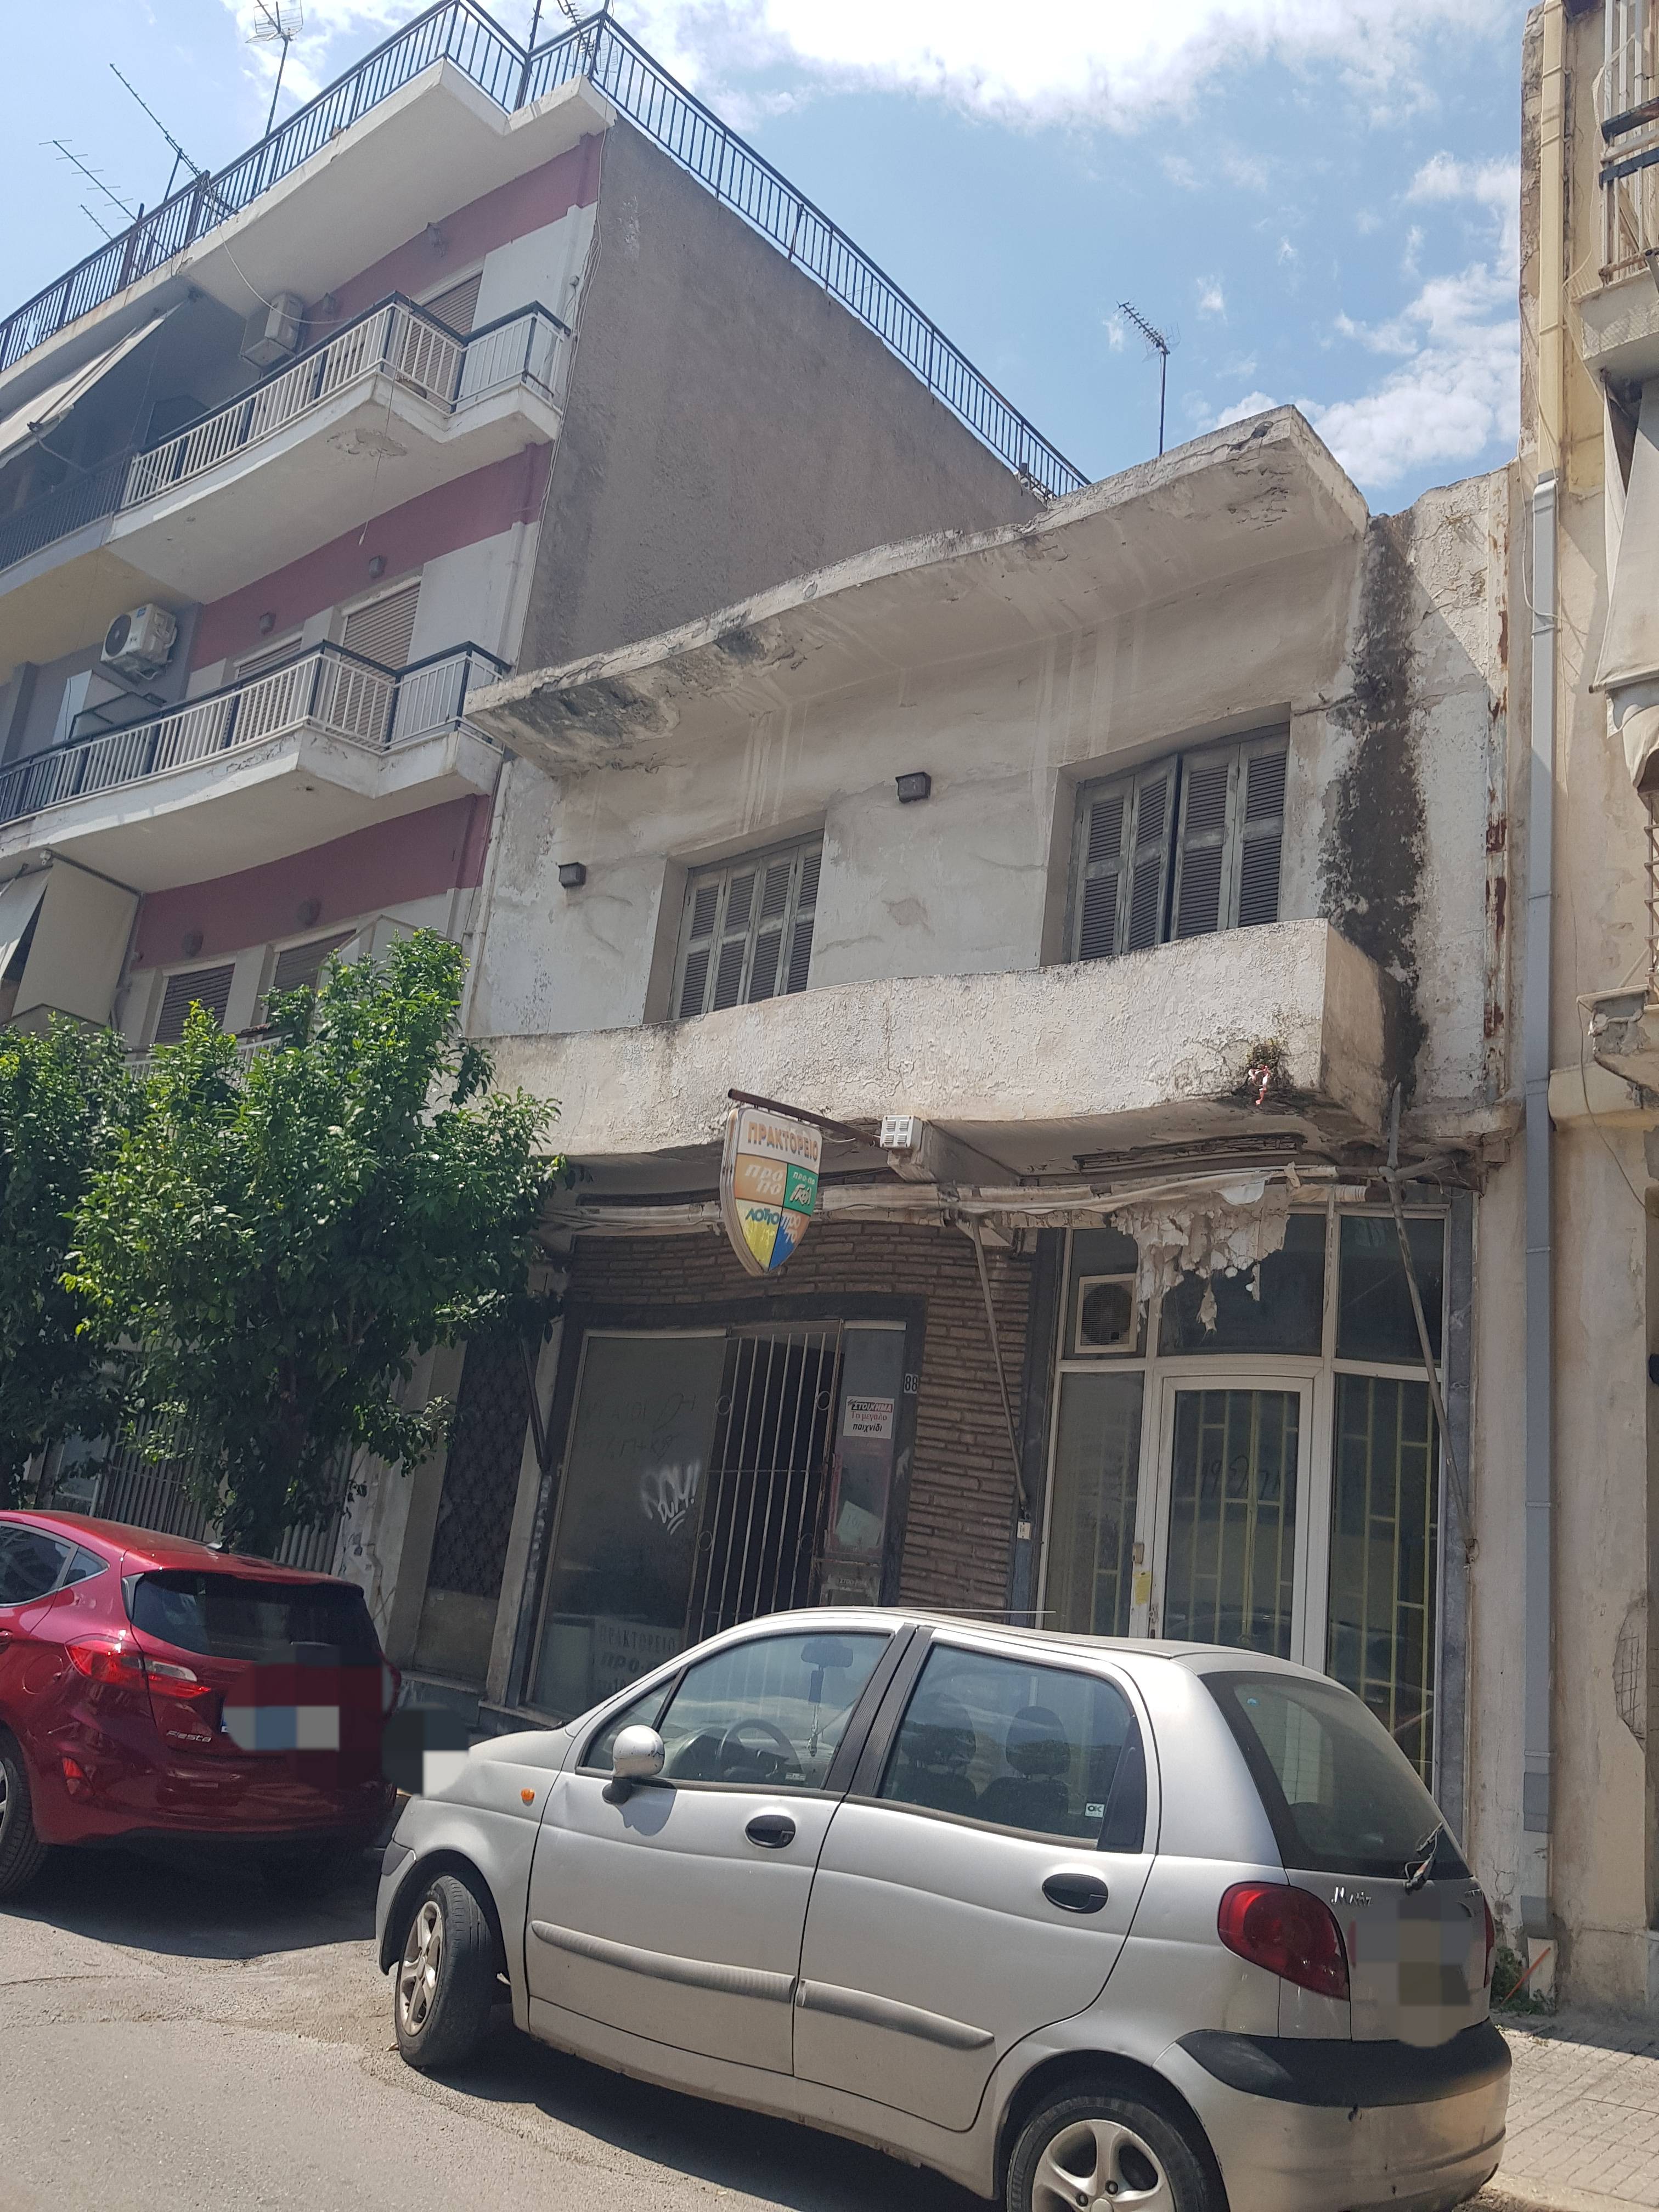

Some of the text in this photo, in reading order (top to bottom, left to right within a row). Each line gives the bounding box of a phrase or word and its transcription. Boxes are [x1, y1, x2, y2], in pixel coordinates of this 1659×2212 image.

[747, 1121, 819, 1162] ΠΡΑΚΤΟΡΕΙΟ
[905, 1375, 918, 1392] 88
[166, 1730, 212, 1742] Fiesta
